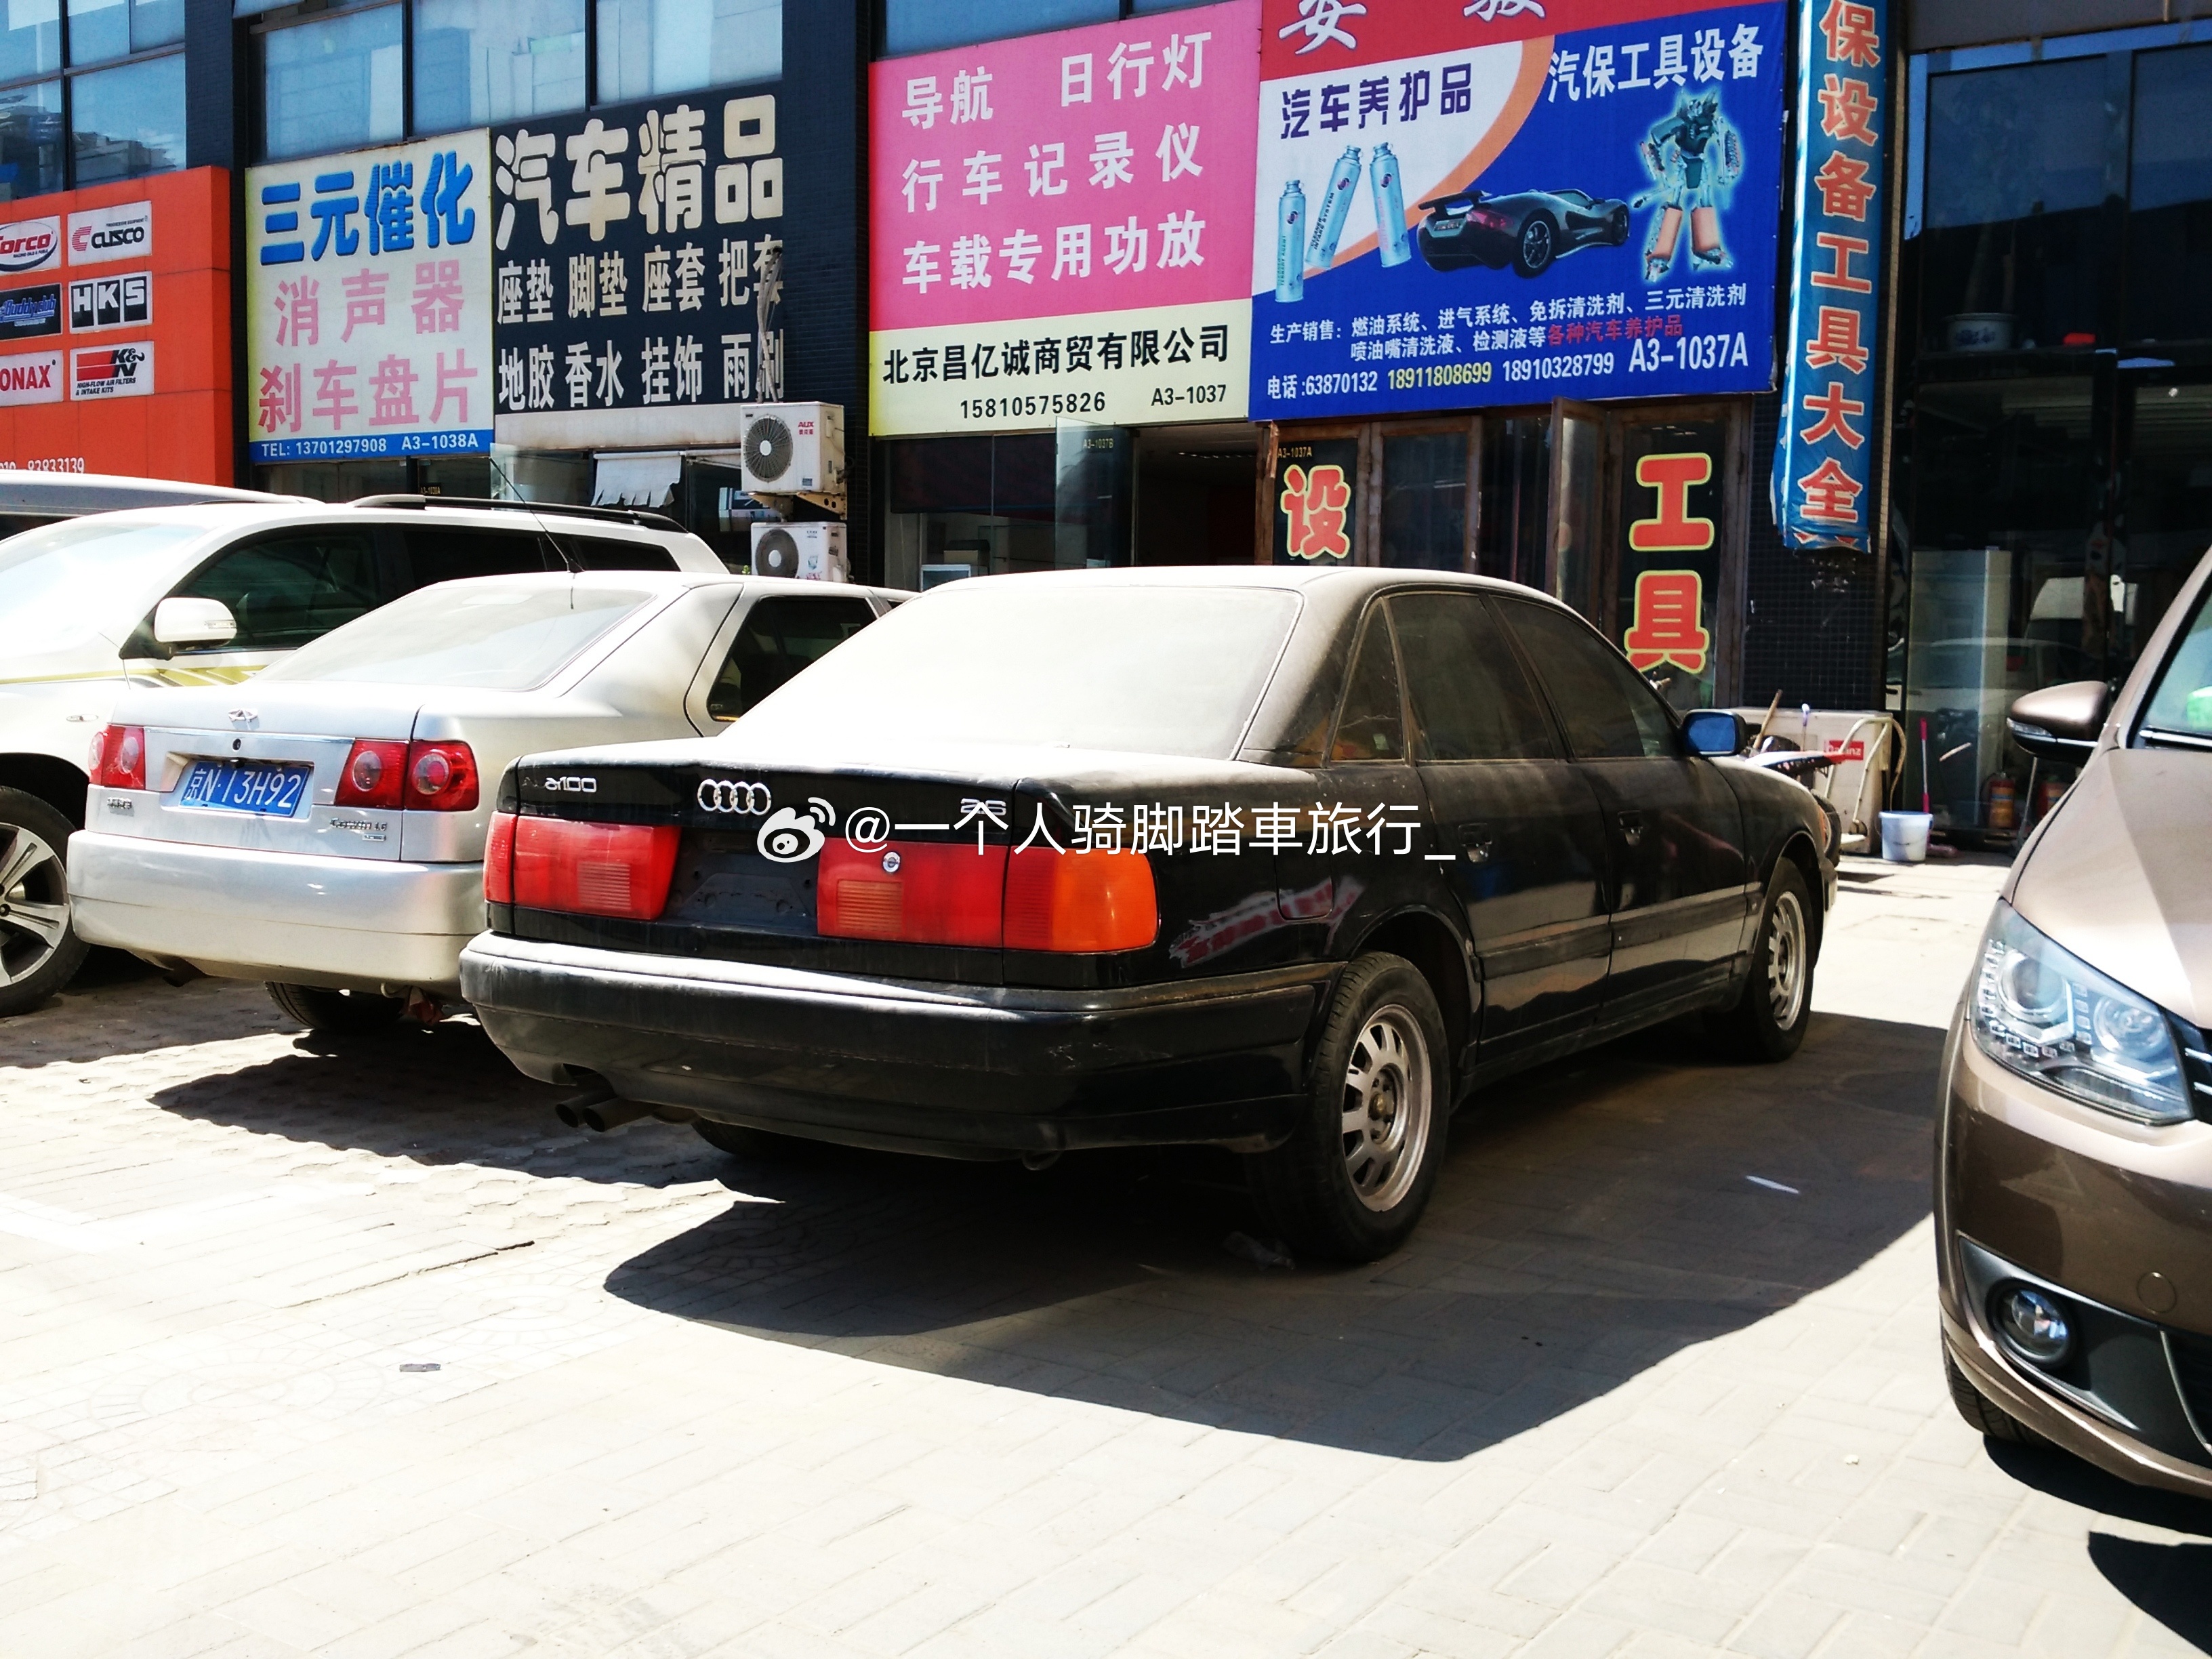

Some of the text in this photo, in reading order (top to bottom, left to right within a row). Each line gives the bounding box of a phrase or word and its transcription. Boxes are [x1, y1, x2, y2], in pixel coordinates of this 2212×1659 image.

[902, 32, 1212, 129] 导航 日行灯
[1280, 63, 1472, 140] 汽车养护品
[1548, 24, 1764, 103] 汽保工具设备
[495, 94, 783, 251] 汽车精品
[901, 123, 1203, 213] 行车记录仪
[91, 226, 144, 249] CUSCO
[260, 151, 475, 266] 三元催化
[497, 259, 554, 324] 座垫
[568, 251, 628, 319] 脚垫
[642, 242, 705, 312] 座套
[902, 209, 1206, 294] 车载专用功放
[73, 280, 144, 312] HKS
[274, 260, 464, 346] 消声器
[258, 348, 477, 433] 刹车盘片
[499, 344, 554, 411] 地胶
[565, 340, 624, 408] 香水
[642, 335, 703, 405] 挂饰
[882, 324, 1229, 384] 北京昌亿诚商贸有限公司
[1387, 361, 1492, 390] 18911808699
[1502, 352, 1614, 382] 18910328799
[1628, 331, 1748, 373] A3-1037A
[960, 384, 1227, 419] 15810575826 A3-1037
[262, 433, 479, 457] TEL: 13701297908 A3-1038A
[1281, 464, 1351, 559] 设
